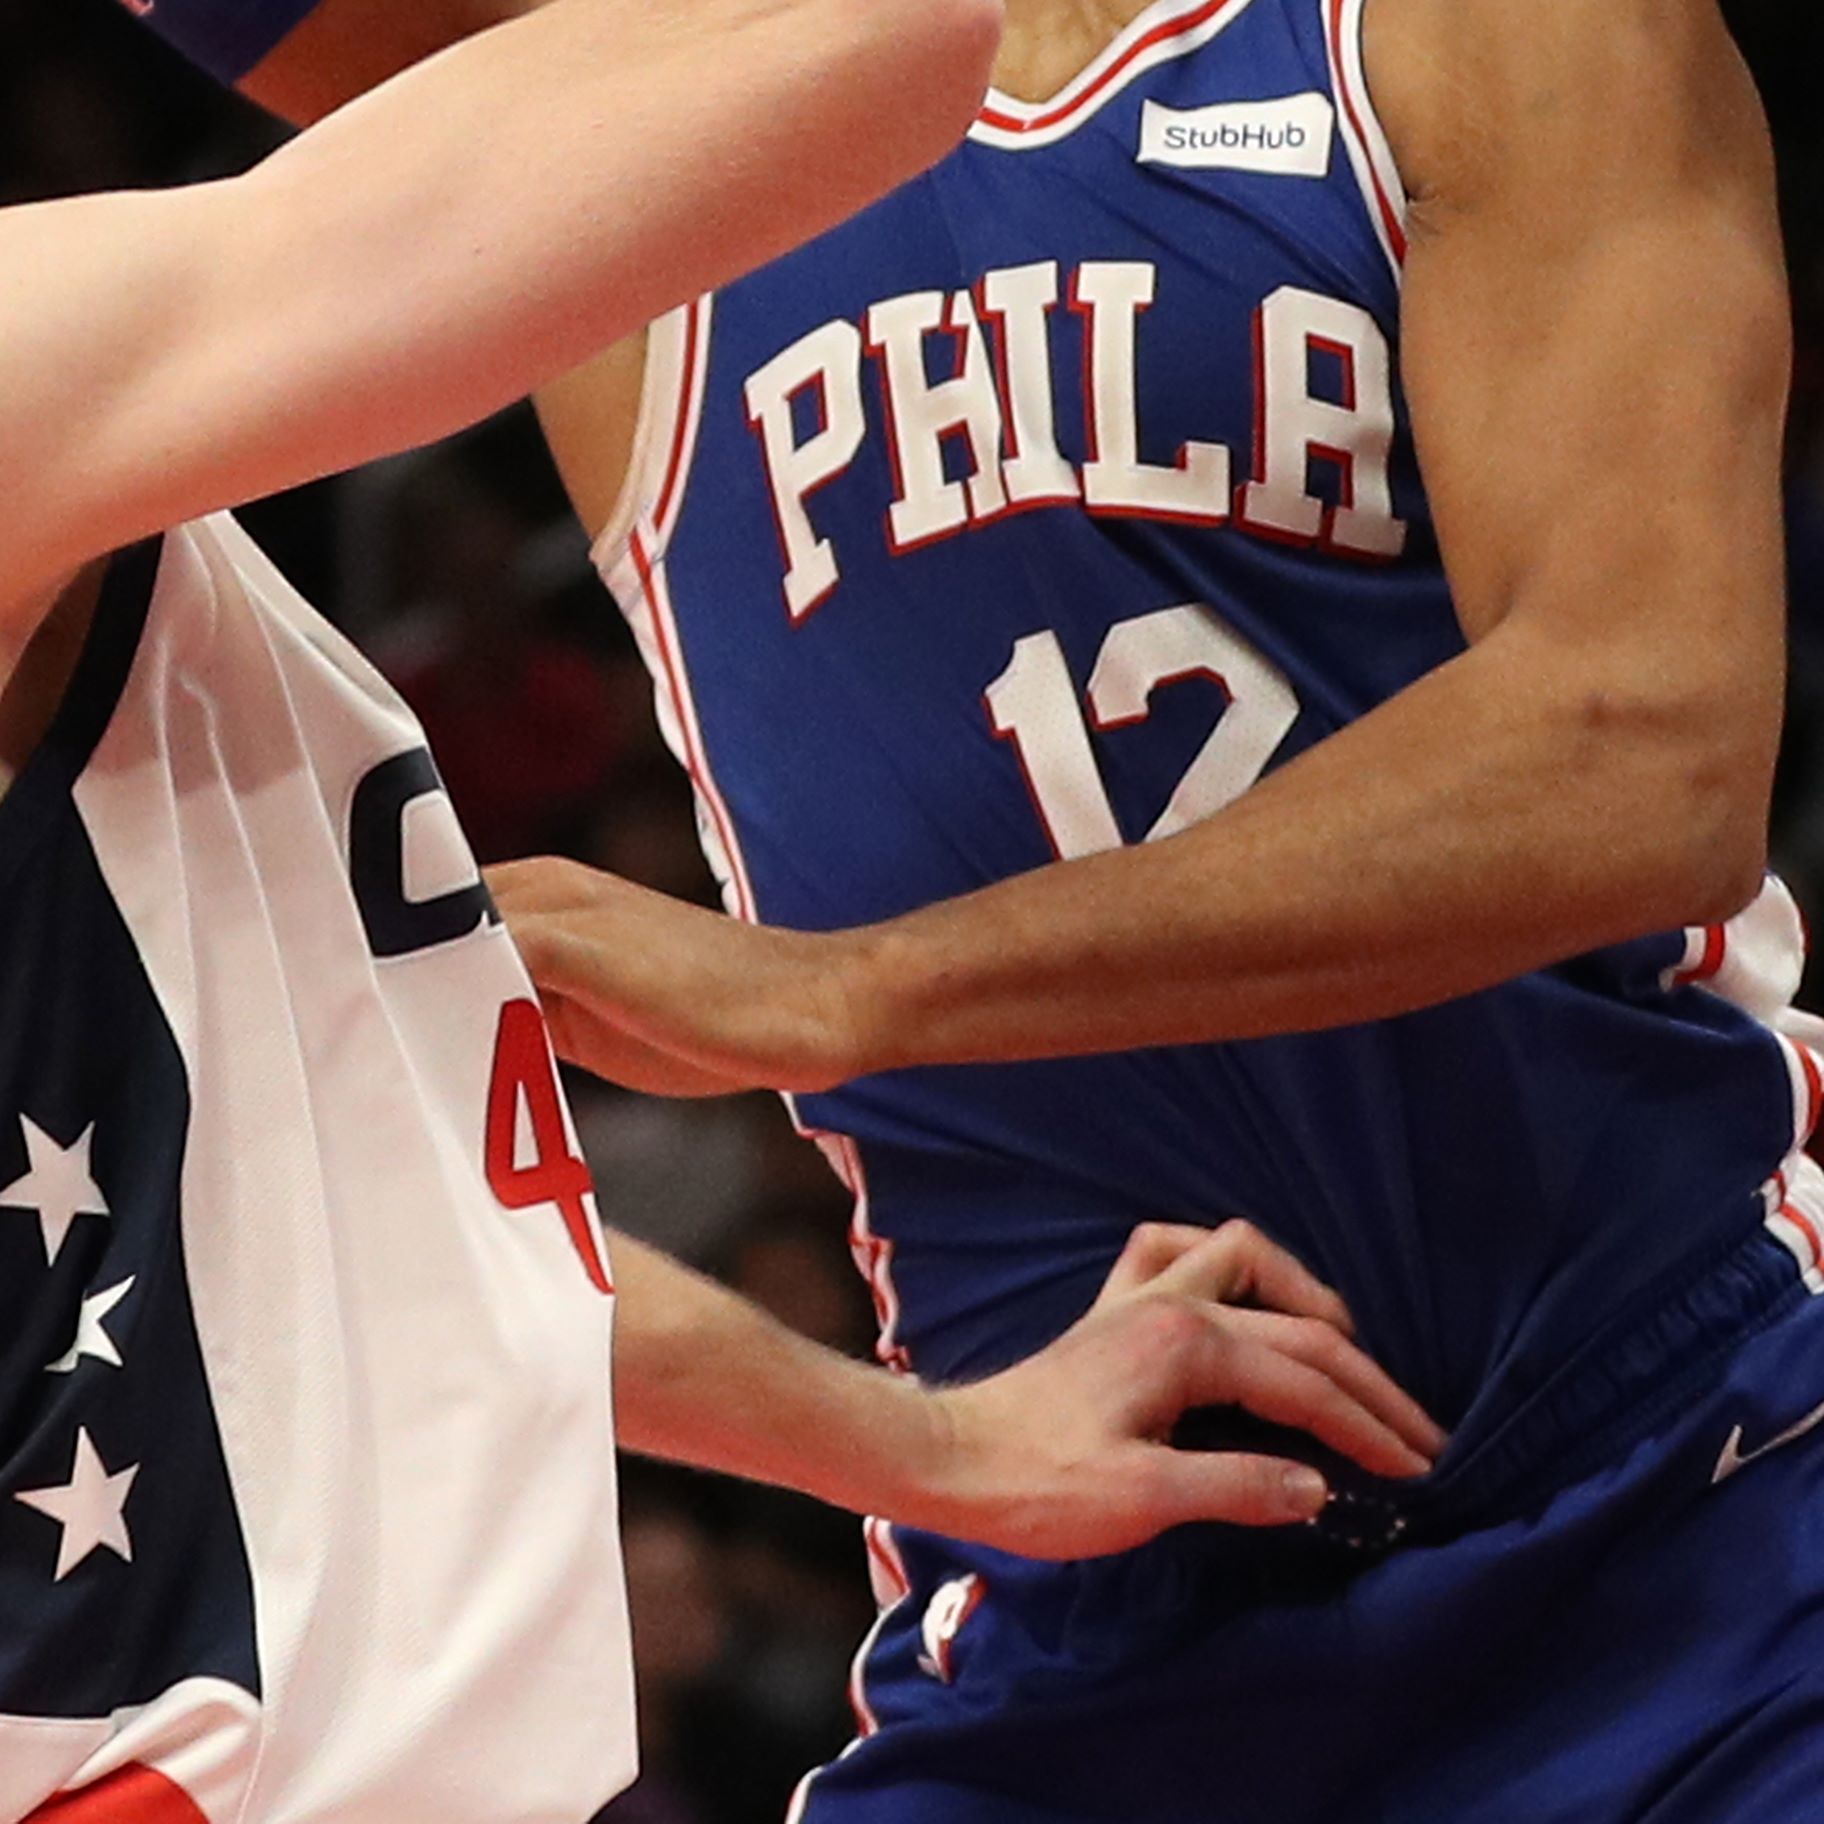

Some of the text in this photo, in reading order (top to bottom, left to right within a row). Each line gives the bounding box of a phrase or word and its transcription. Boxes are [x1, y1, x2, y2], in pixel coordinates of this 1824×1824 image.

[1162, 120, 1306, 151] StubHub
[743, 259, 1406, 630] PHILA
[982, 602, 1300, 862] 12
